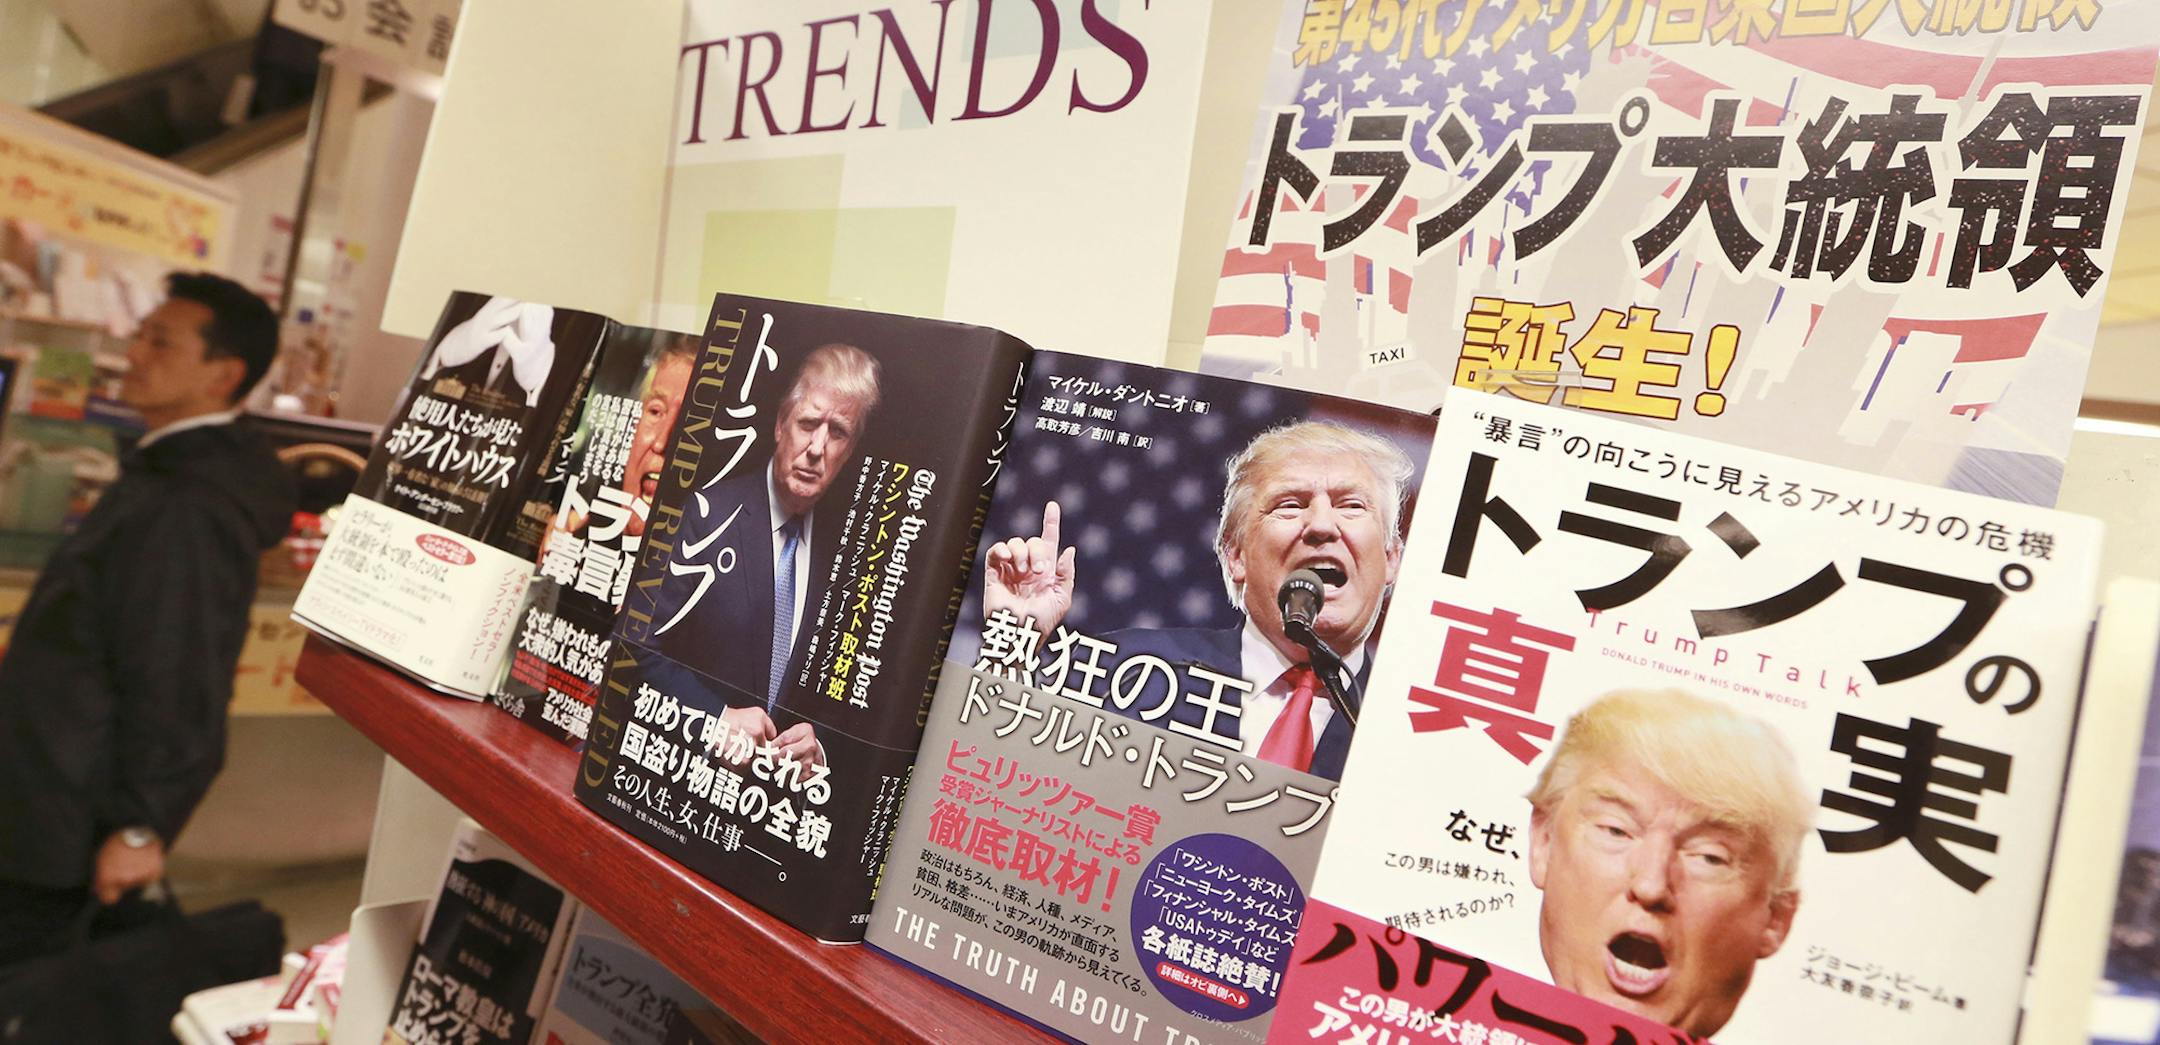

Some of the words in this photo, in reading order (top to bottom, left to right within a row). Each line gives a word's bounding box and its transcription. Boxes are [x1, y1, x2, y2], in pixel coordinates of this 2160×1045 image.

[678, 0, 1149, 145] TRENDS
[1240, 88, 2141, 298] トランプ大統領
[669, 306, 748, 490] TRUMP
[1368, 346, 1405, 365] TAXI
[1453, 296, 1742, 421] 誕生!
[385, 422, 516, 488] ホワイトハウス
[408, 394, 523, 447] 使用人たちが見た
[655, 312, 780, 636] トランプ
[907, 468, 937, 511] The
[484, 572, 528, 663] 全米ベストセラー
[825, 462, 910, 702] ワシントン・ポスト取材班
[864, 514, 928, 650] Washington
[1440, 451, 2042, 716] トランプの
[583, 497, 686, 790] REVEALED
[849, 651, 883, 710] Post
[972, 608, 1254, 753] 熱狂の王
[1586, 607, 1730, 666] Trump
[1756, 653, 1864, 699] Talk
[1601, 646, 1648, 667] DONALD
[1651, 660, 1692, 679] TRUMP
[1694, 671, 1707, 683] IN
[1710, 675, 1729, 689] HIS
[1732, 681, 1761, 697] OWN
[1764, 689, 1809, 710] WORDS
[618, 722, 833, 859] 国盗り物語の全貌
[633, 682, 832, 806] 初めて明かされる
[958, 675, 1340, 838] ドナルド・トランプ
[1407, 597, 1577, 767] 真
[1818, 711, 2016, 895] 実
[928, 801, 1121, 913] 徹底取材!
[939, 774, 1141, 865] 受賞ジャーナリストによる
[1385, 851, 1515, 887] この男は嫌われ、
[1445, 809, 1520, 860] なぜ、
[920, 848, 1118, 943] 政治はもちろん、経済、人種、メディア、
[1155, 862, 1304, 930] 「ニューヨーク・タイムズ」
[1173, 847, 1294, 905] 「ワシントン・ポスト」
[895, 906, 940, 950] THE
[951, 933, 1039, 995] TRUTH
[1050, 979, 1149, 1043] ABOUT
[912, 883, 1147, 997] リアルな問題が、この男の軌跡から見えてくる。
[1142, 925, 1281, 998] 各紙誌絶賛!
[1159, 906, 1280, 963] 「USAトゥデイ」など
[412, 954, 515, 1040] ローマ教皇は
